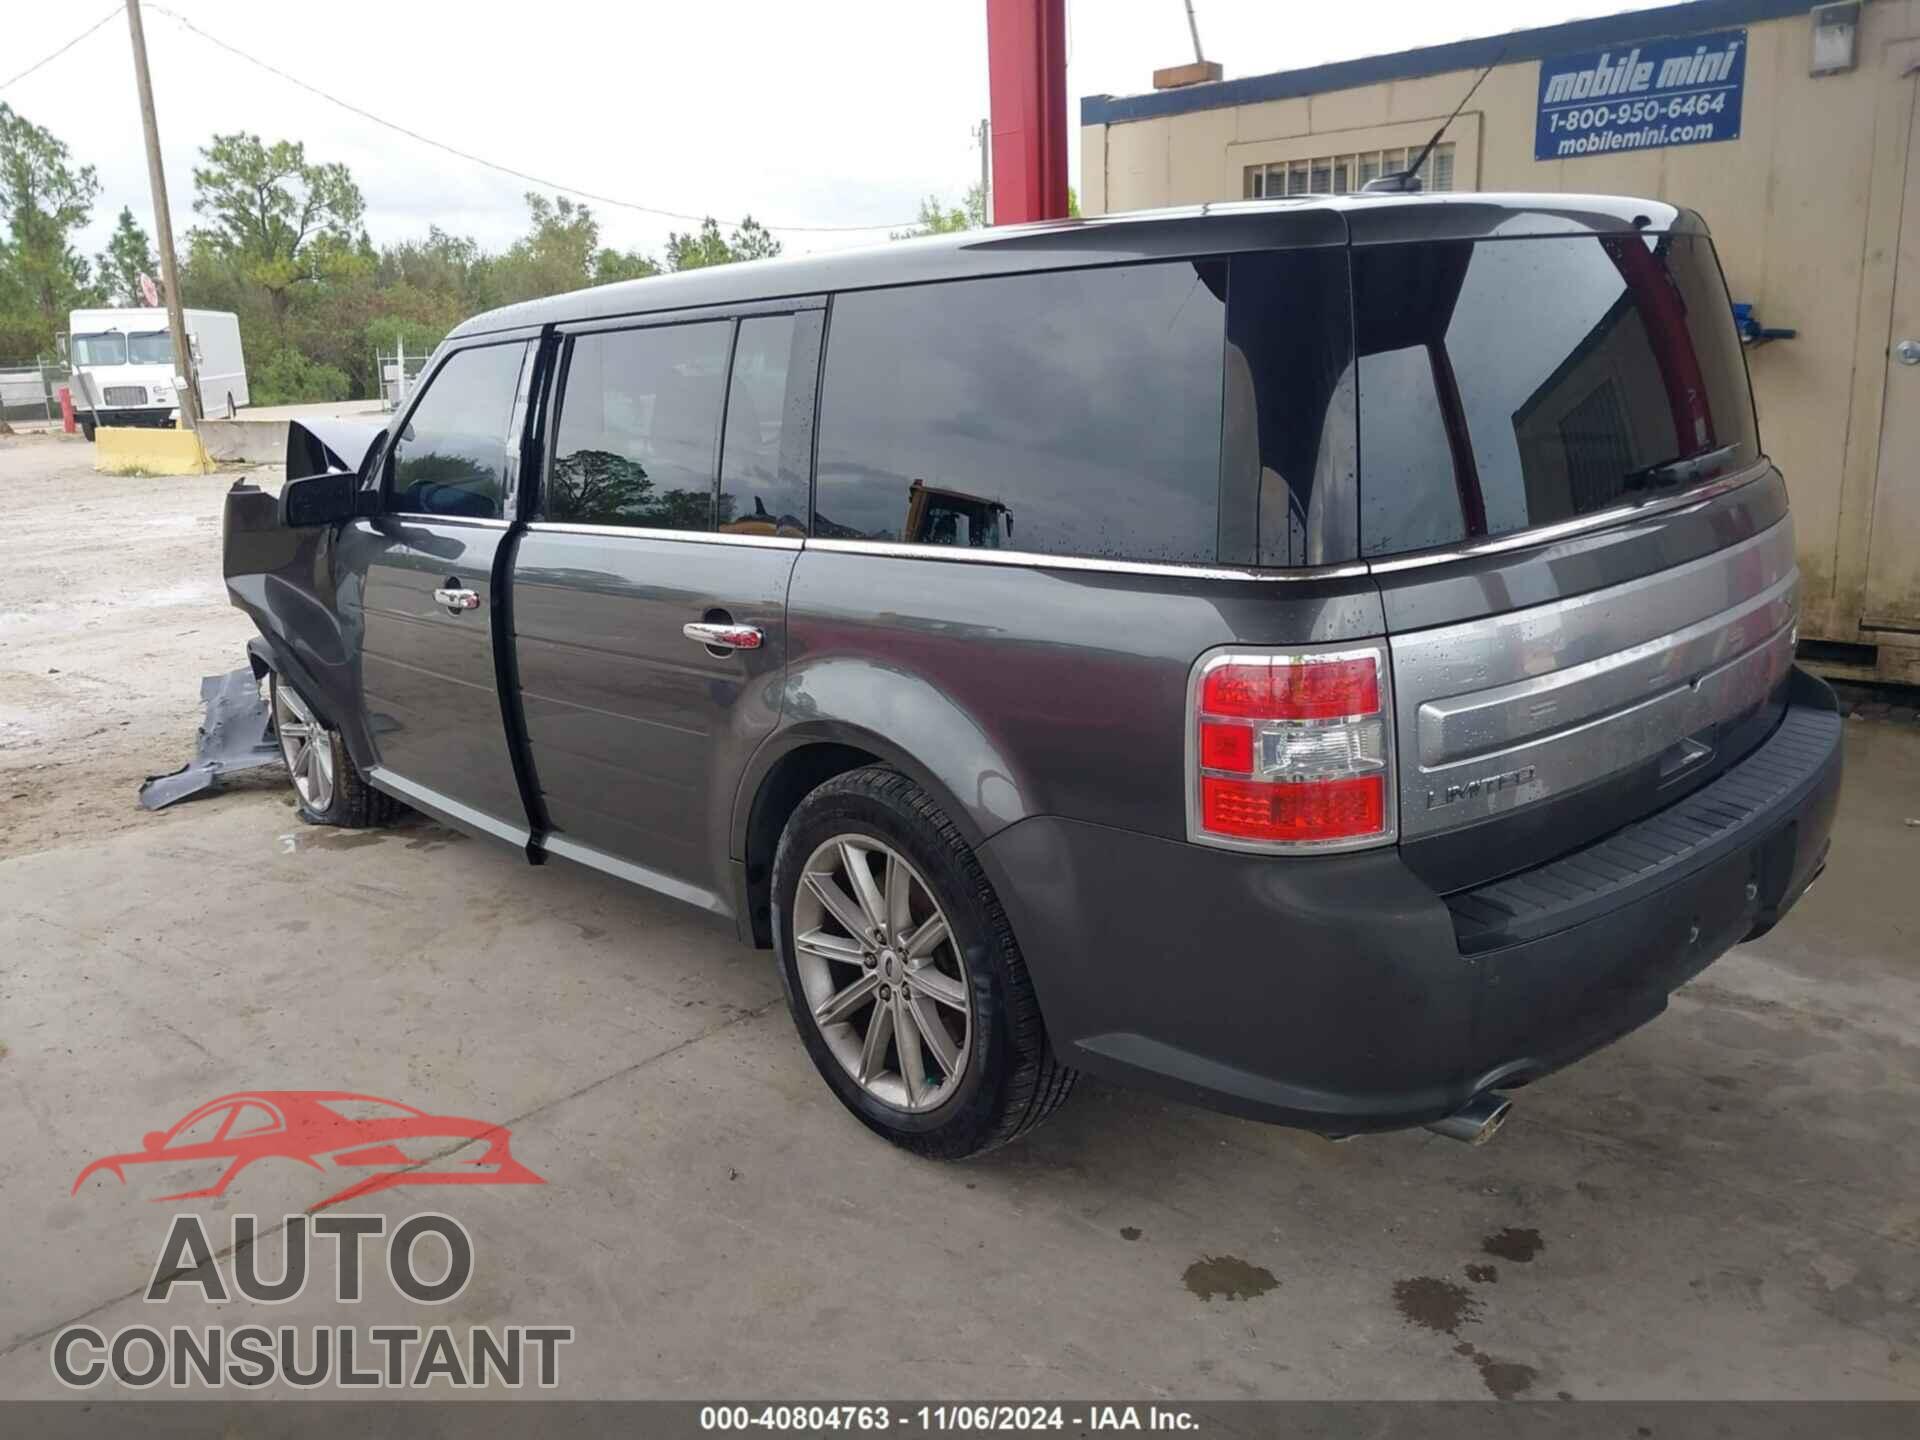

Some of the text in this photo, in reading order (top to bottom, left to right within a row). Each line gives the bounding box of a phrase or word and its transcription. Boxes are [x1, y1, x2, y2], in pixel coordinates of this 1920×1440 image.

[1544, 43, 1738, 103] mobile mini
[1550, 92, 1726, 132] 1-800-950-6464
[1558, 123, 1713, 155] mobilemini.com
